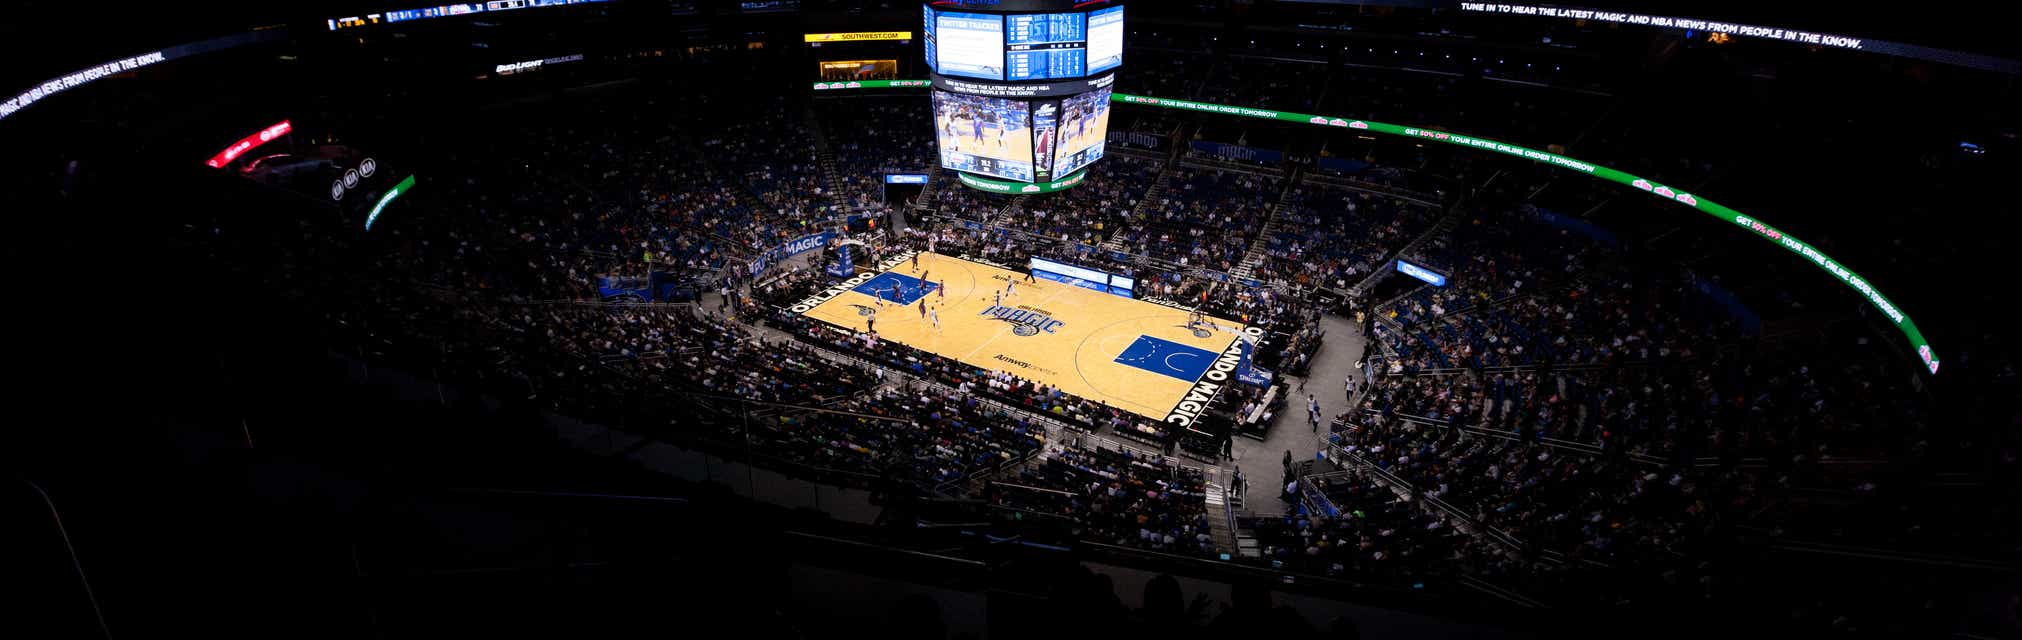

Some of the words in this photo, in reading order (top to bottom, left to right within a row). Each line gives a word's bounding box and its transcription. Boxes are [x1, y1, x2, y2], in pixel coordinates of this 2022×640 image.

[1461, 2, 1484, 11] TUNE
[1486, 4, 1496, 12] IN
[1498, 4, 1510, 13] TO
[1512, 5, 1537, 15] HEAR
[1538, 7, 1556, 16] THE
[1558, 8, 1594, 19] LATEST
[1594, 11, 1626, 22] MAGIC
[1627, 14, 1650, 24] AND
[1651, 16, 1673, 27] NBA
[1675, 19, 1706, 30] NEWS
[1707, 22, 1738, 33] FROM
[1740, 25, 1783, 39] PEOPLE
[1784, 30, 1797, 40] IN
[1799, 32, 1821, 43] THE
[1822, 35, 1862, 49] KNOW.
[63, 72, 85, 88] FROM
[83, 65, 111, 82] PEOPLE
[110, 62, 121, 73] IN
[119, 57, 138, 70] THE
[137, 51, 165, 66] KNOW.
[1176, 101, 1196, 109] ENTIRE
[1197, 103, 1218, 112] ONLINE
[1219, 105, 1239, 113] ORDER
[1241, 108, 1278, 118] TOMORROW
[1435, 132, 1449, 140] OFF
[1450, 135, 1471, 145] YOUR
[1471, 139, 1497, 150] ENTIRE
[1498, 144, 1524, 156] ONLINE
[1525, 150, 1551, 161] ORDER
[1551, 155, 1596, 173] TOMORROW
[786, 236, 823, 255] MAGIC
[1736, 215, 1752, 227] GET
[1751, 221, 1767, 234] 50%
[1766, 228, 1782, 240] OFF
[1781, 235, 1803, 252] YOUR
[1802, 246, 1826, 266] ENTIRE
[1825, 260, 1850, 281] ONLINE
[1850, 276, 1872, 296] ORDER
[791, 272, 875, 313] ORLANDO
[978, 305, 1066, 334] MAGIC
[993, 354, 1032, 369] Amway
[1206, 326, 1264, 381] OLANDO
[1167, 381, 1219, 427] MAGIC
